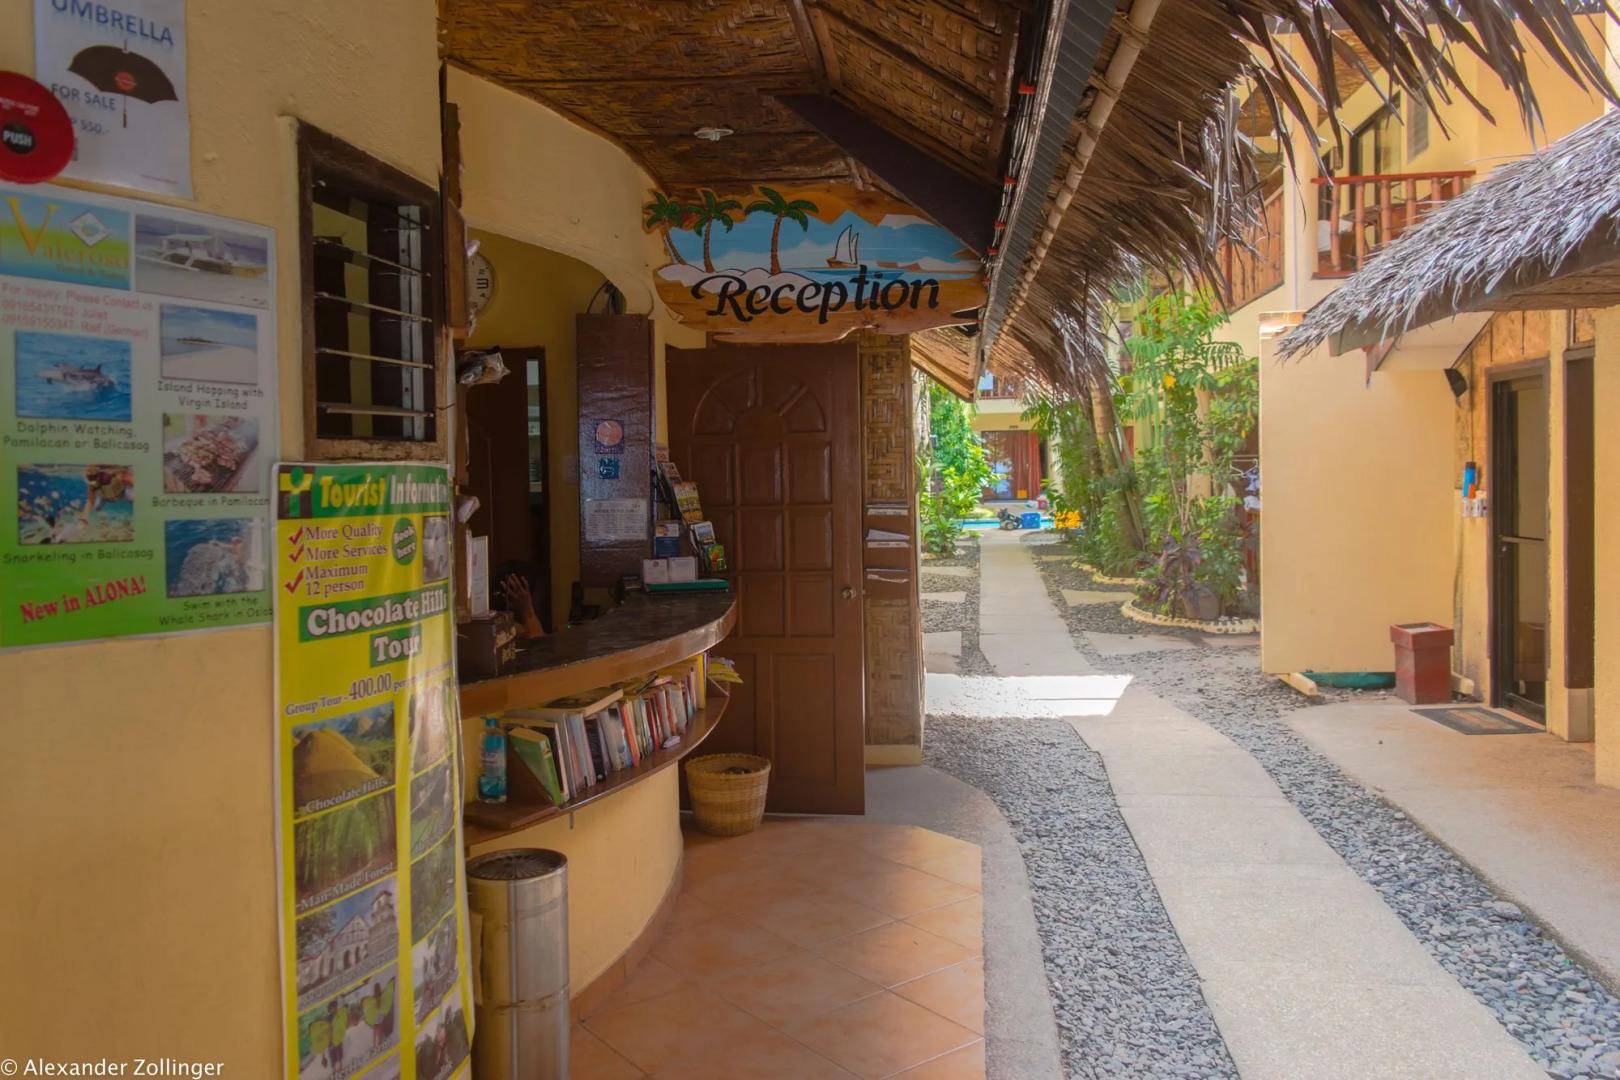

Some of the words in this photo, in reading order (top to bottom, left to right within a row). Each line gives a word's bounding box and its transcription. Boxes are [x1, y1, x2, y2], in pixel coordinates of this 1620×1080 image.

[52, 0, 174, 46] UMBRELLA
[52, 84, 80, 101] FOR
[85, 92, 116, 111] SALE
[3, 130, 33, 147] PUSH
[4, 197, 130, 269] Valeroso
[2, 283, 20, 296] For
[66, 290, 101, 304] Please
[104, 294, 140, 309] Contact
[691, 264, 939, 324] Reception
[157, 381, 193, 393] Island
[197, 384, 239, 399] Hopping
[242, 388, 264, 398] with
[179, 397, 211, 410] Virgin
[215, 398, 247, 410] Island
[17, 421, 69, 436] Dolphin
[4, 435, 70, 449] Pamilacan
[75, 440, 88, 448] or
[319, 472, 386, 508] Tourist
[152, 496, 205, 509] Barbeque
[208, 497, 218, 506] in
[305, 525, 339, 542] More
[342, 522, 383, 541] Quality
[393, 526, 415, 545] Book
[3, 549, 76, 564] Snorkeling
[81, 551, 92, 561] in
[305, 545, 340, 562] More
[343, 543, 388, 559] Services
[305, 562, 369, 581] Maximum
[20, 601, 59, 624] New
[62, 593, 81, 613] in
[85, 574, 146, 609] ALONA!
[306, 581, 321, 597] 12
[324, 579, 364, 598] person
[306, 598, 420, 637] Chocolate
[421, 588, 448, 616] Hills
[373, 633, 421, 663] Tour
[285, 701, 318, 717] Group
[320, 695, 342, 707] Tour
[305, 786, 360, 814] Chocolate
[362, 778, 388, 795] Hills
[299, 880, 361, 912] Man-Made
[364, 862, 394, 882] Forest
